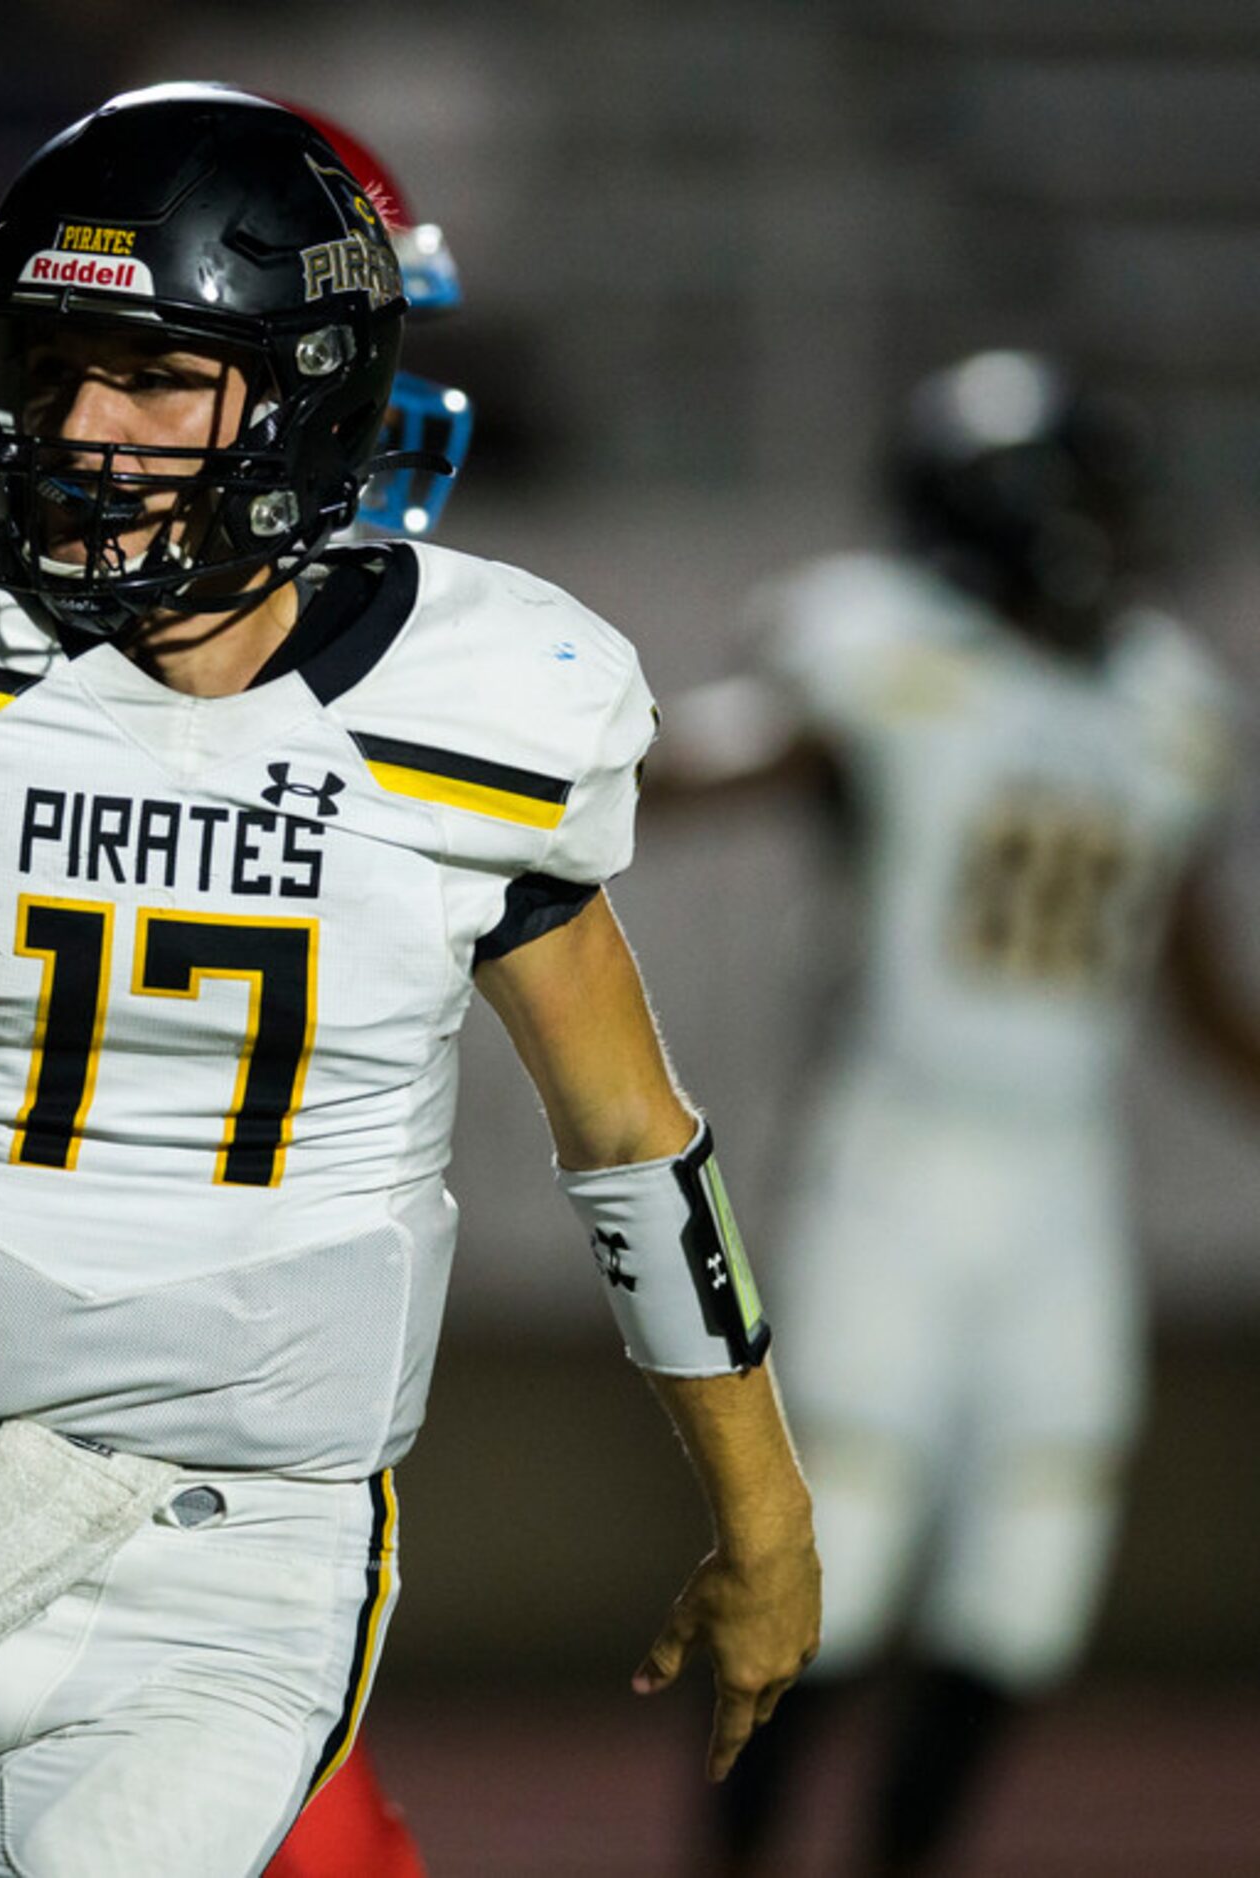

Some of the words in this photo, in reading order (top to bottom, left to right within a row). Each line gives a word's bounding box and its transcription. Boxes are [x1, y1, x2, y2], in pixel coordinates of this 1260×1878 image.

[61, 225, 136, 255] PIRATES
[299, 239, 401, 303] PIRA
[32, 258, 135, 287] Riddell
[19, 787, 326, 899] PIRATES
[9, 893, 320, 1188] 17
